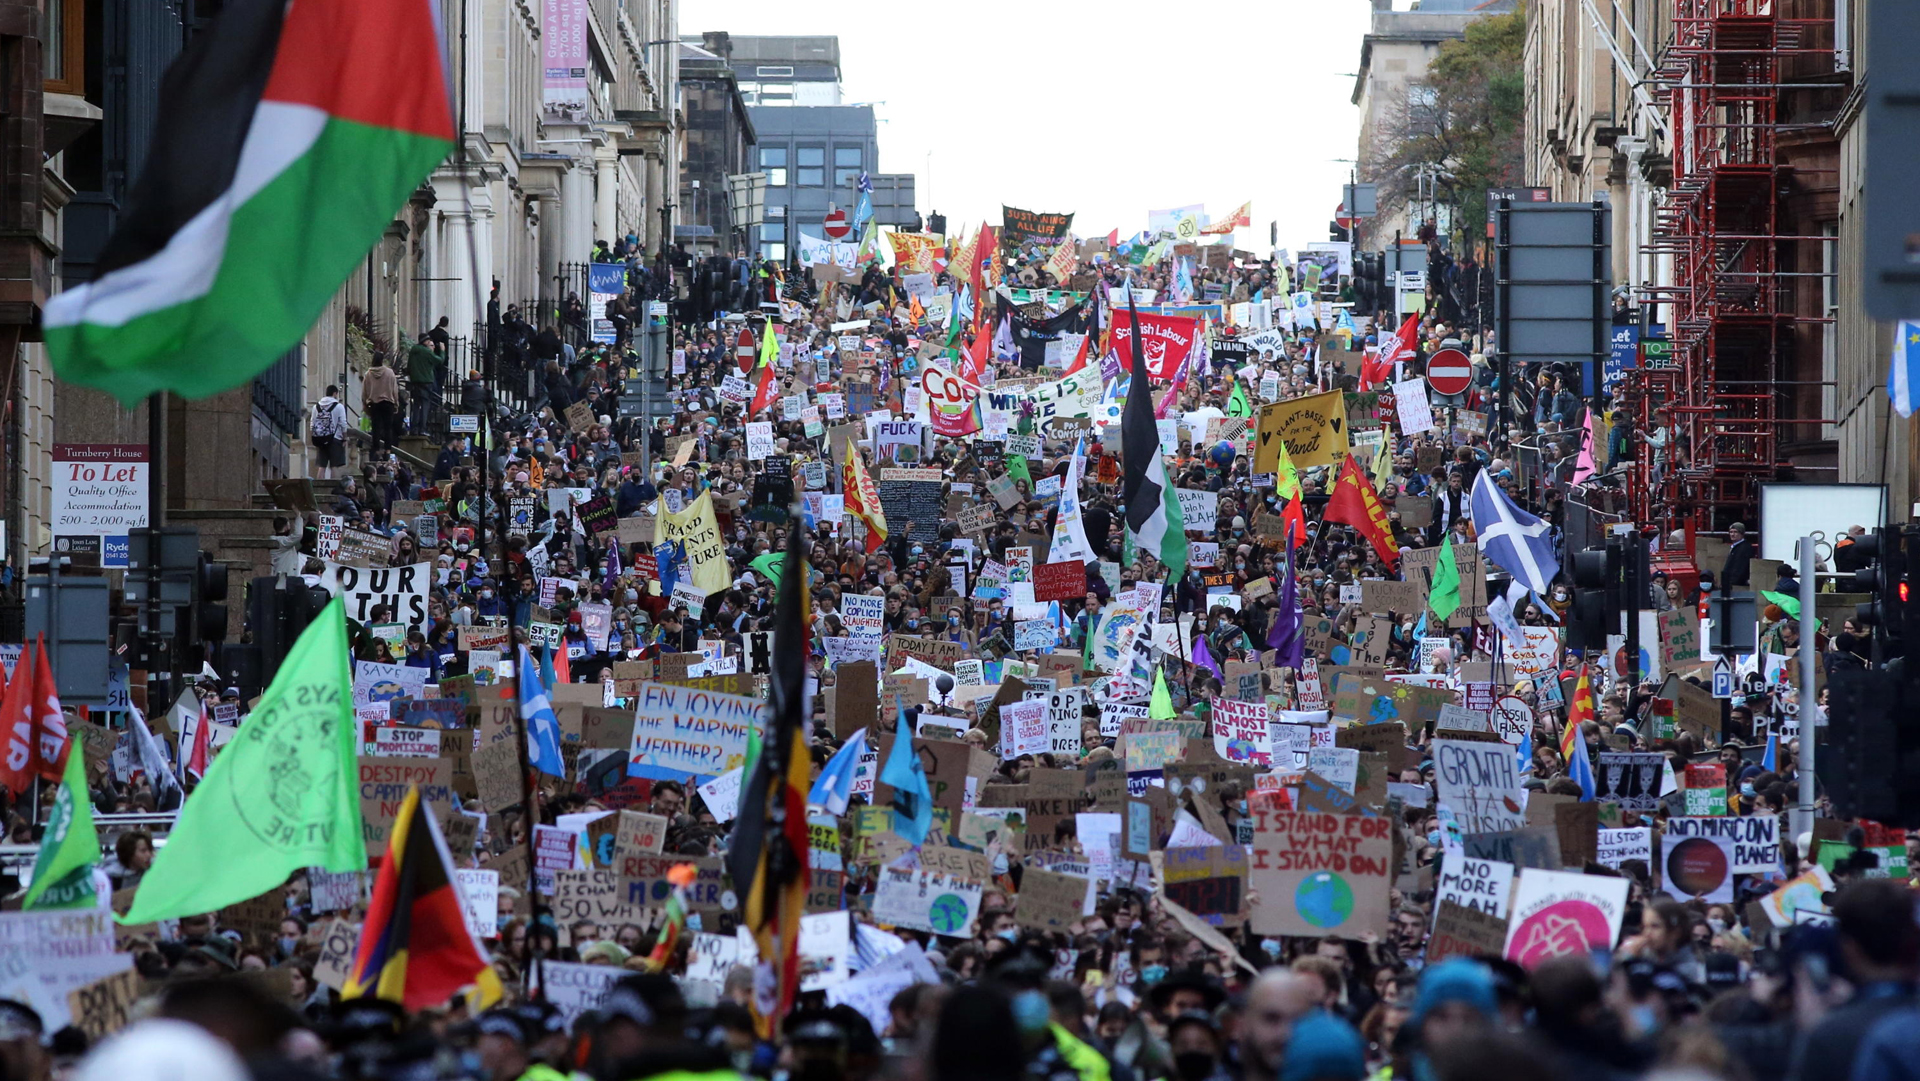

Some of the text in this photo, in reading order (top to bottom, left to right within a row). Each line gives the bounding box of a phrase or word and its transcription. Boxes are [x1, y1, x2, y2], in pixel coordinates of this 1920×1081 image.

[547, 15, 557, 58] Grade A
[1490, 192, 1500, 200] To
[1017, 221, 1055, 235] ALL LIFE
[1155, 326, 1189, 346] Labour
[1253, 335, 1283, 351] WORLD
[1055, 377, 1077, 398] IS
[1396, 391, 1425, 407] BLAH
[1400, 403, 1427, 420] BLAH
[748, 425, 770, 436] END
[881, 423, 917, 436] FUCK
[1063, 421, 1079, 430] PAS
[1402, 419, 1431, 435] BLAH
[65, 447, 142, 460] Turnberry House
[68, 464, 138, 482] To Let
[68, 485, 138, 497] Quality Office
[1178, 493, 1204, 502] BLAH
[64, 501, 142, 511] Accommodation
[1185, 503, 1205, 513] blah
[59, 516, 82, 525] 500
[90, 516, 124, 527] 2,000
[320, 516, 336, 525] END
[962, 516, 977, 524] NOT
[1182, 511, 1216, 525] BLAH
[1006, 548, 1029, 558] TIME
[336, 566, 416, 593] OUR
[977, 578, 999, 587] STOP
[1225, 573, 1235, 583] UP
[845, 597, 882, 609] NO MORE
[846, 607, 882, 618] COPLICIT
[841, 615, 882, 628] SLAUGHTER
[895, 637, 956, 656] TODAY I AM
[1016, 640, 1040, 650] CHANGE
[662, 655, 687, 666] BURN
[1353, 647, 1381, 664] The
[362, 662, 400, 679] SAVE
[956, 663, 977, 671] SYSTEM
[1717, 675, 1727, 694] P
[1014, 707, 1045, 718] SOCIALIST
[1104, 703, 1147, 717] NO MORE
[1212, 697, 1267, 717] EARTH'S
[639, 716, 665, 730] THE
[1213, 710, 1268, 729] ALMOST
[391, 730, 425, 742] STOP
[1018, 725, 1045, 735] CLIMATE
[1215, 723, 1267, 743] AS HOT
[376, 742, 439, 754] PROMISING
[635, 735, 723, 764] WEATHER?
[1311, 757, 1336, 766] POWER
[1439, 746, 1513, 789] GROWTH
[359, 765, 437, 783] DESTROY
[1686, 790, 1710, 798] FUND
[622, 817, 660, 835] THERE
[1255, 812, 1389, 840] I STAND FOR
[1669, 819, 1699, 836] NO
[632, 833, 655, 847] NO
[1289, 834, 1361, 854] WHAT
[1617, 832, 1644, 843] STOP
[1734, 844, 1779, 865] PLANET
[1253, 850, 1387, 876] I STAND ON
[1462, 861, 1491, 879] NO
[556, 872, 587, 882] THE
[556, 885, 567, 897] IS
[1441, 873, 1497, 897] MORE
[560, 899, 590, 919] SO
